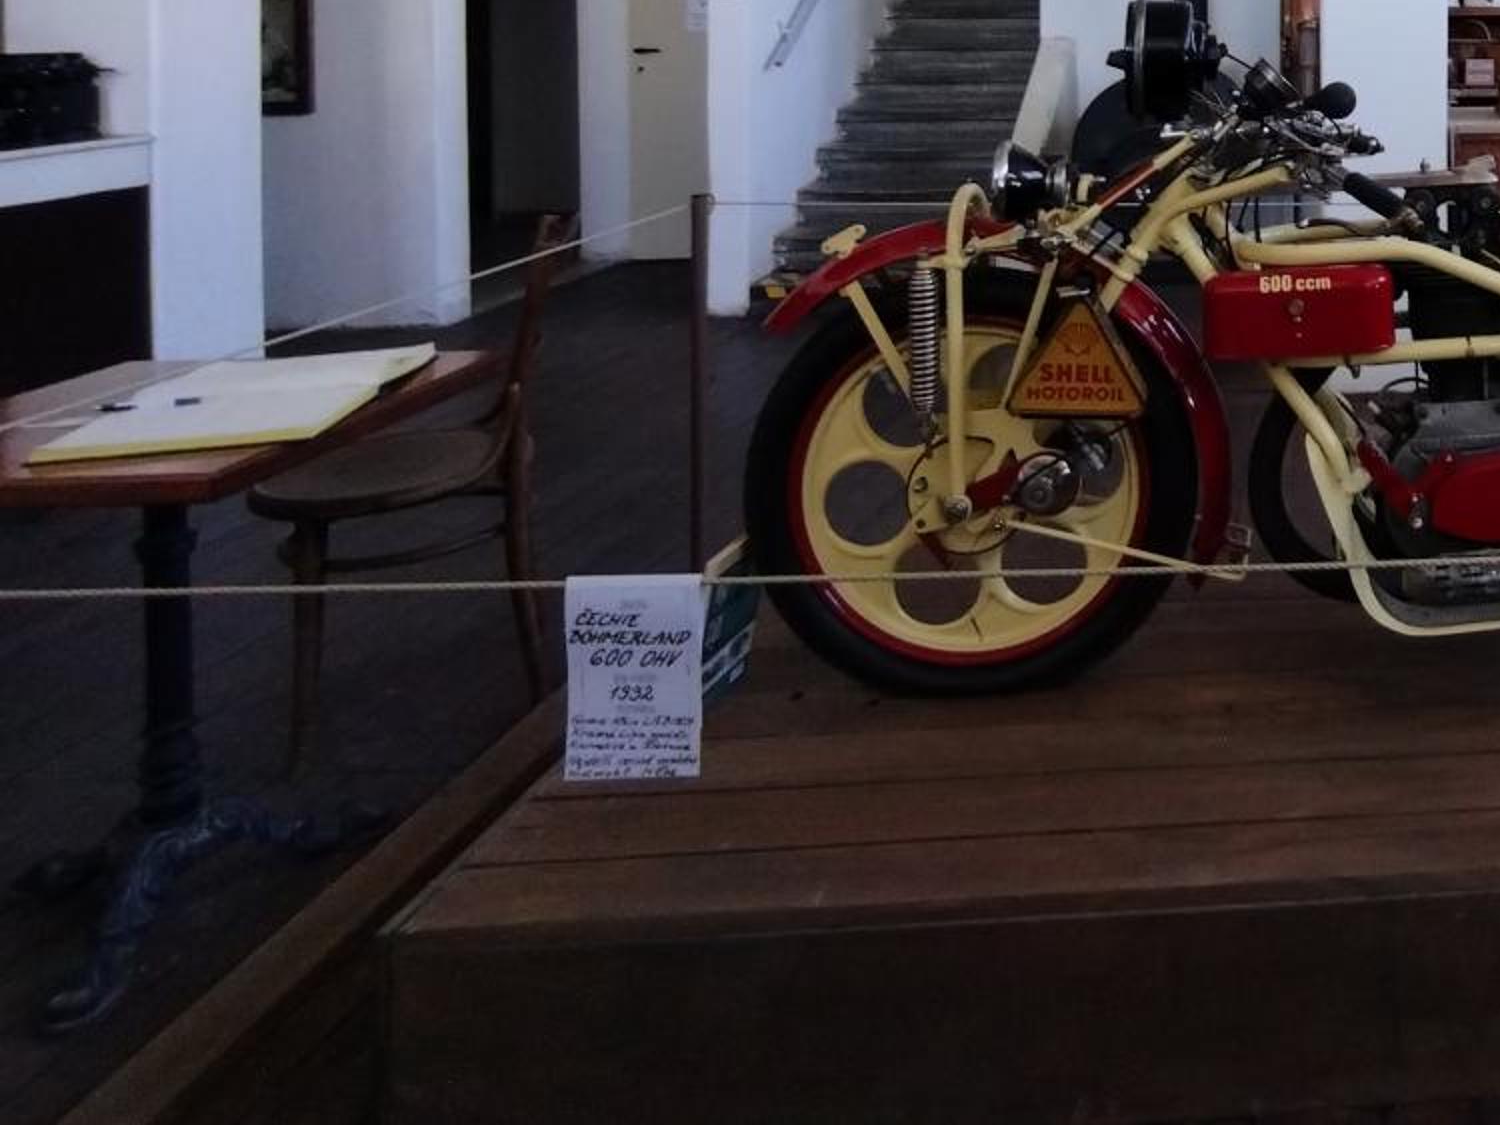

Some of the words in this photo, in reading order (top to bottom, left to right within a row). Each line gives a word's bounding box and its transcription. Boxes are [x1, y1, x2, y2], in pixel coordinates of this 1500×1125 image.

[1259, 275, 1294, 293] 600
[1295, 276, 1331, 291] ccm
[1039, 362, 1116, 385] SHELL
[1026, 386, 1125, 403] MOTOROIL
[589, 649, 633, 668] 600
[640, 650, 684, 668] OHV
[609, 684, 655, 702] 1932
